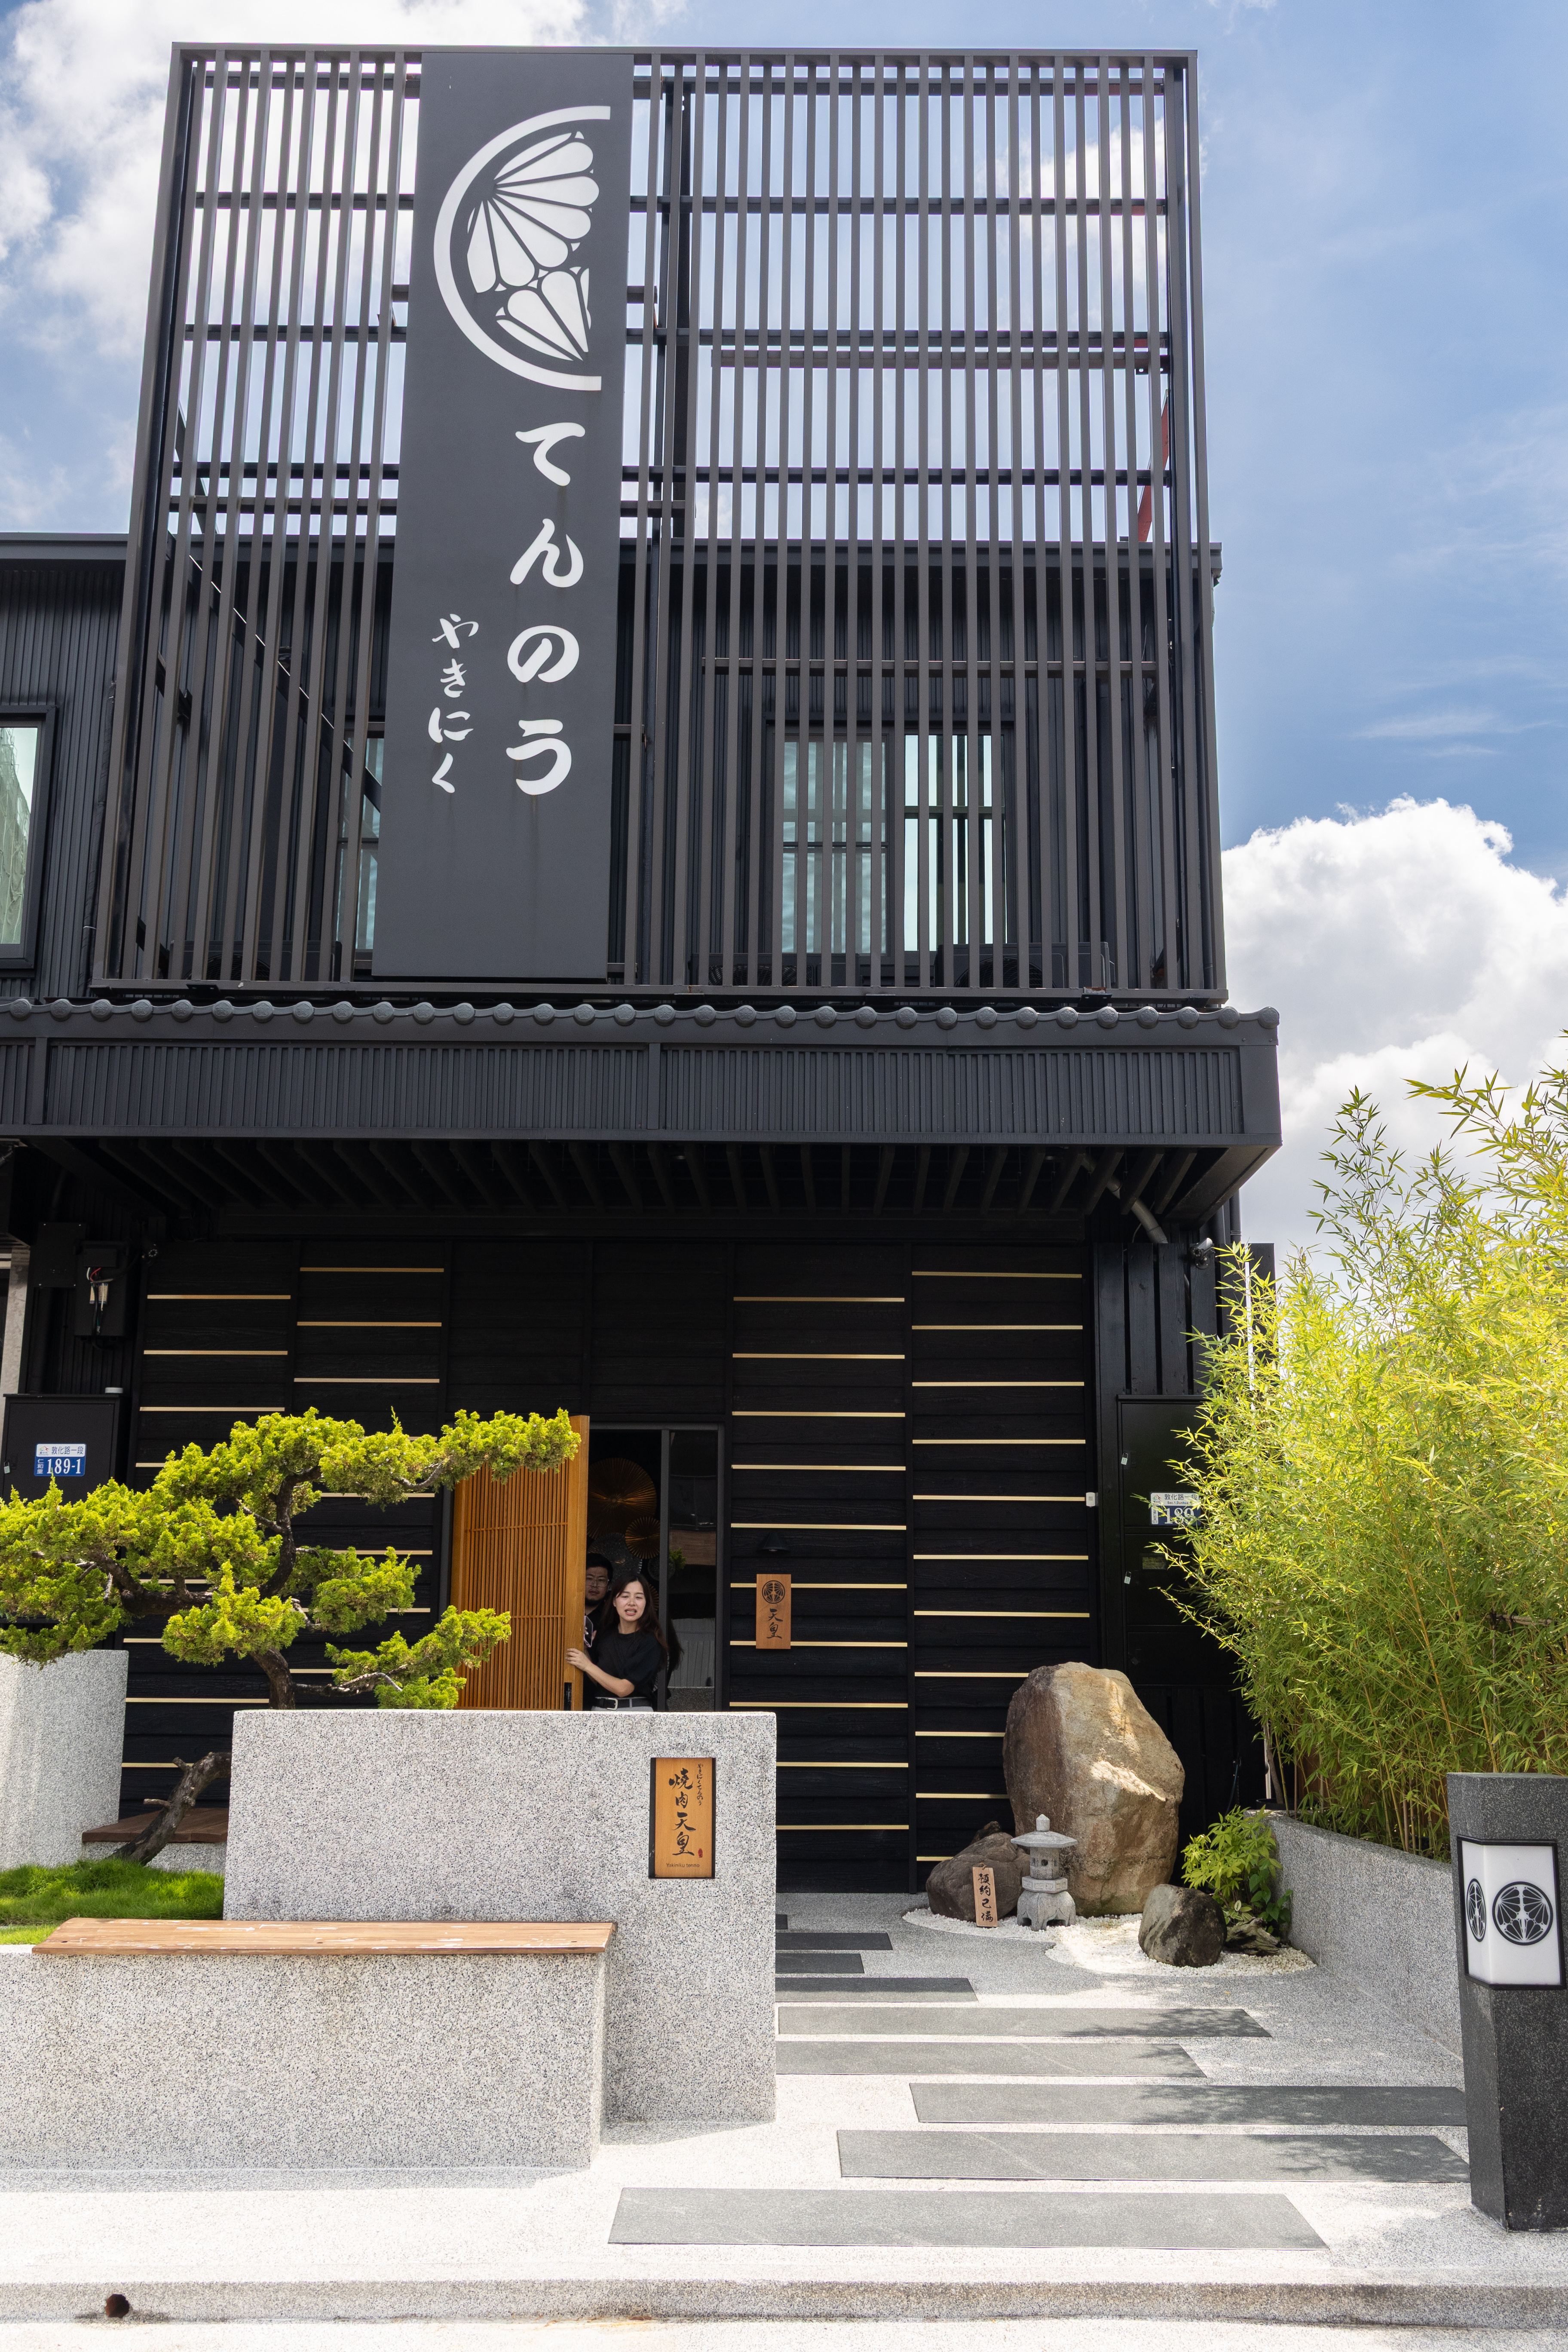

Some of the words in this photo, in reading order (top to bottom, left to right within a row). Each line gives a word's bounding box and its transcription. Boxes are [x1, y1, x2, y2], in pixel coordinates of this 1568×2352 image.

[506, 422, 585, 795] てんのう
[429, 613, 478, 793] やきにく
[46, 1458, 81, 1474] 189-1
[51, 1446, 83, 1455] 敦化路一段
[1164, 1507, 1194, 1525] 189
[766, 1608, 783, 1639] 天皇
[669, 1768, 696, 1856] 燒肉天皇
